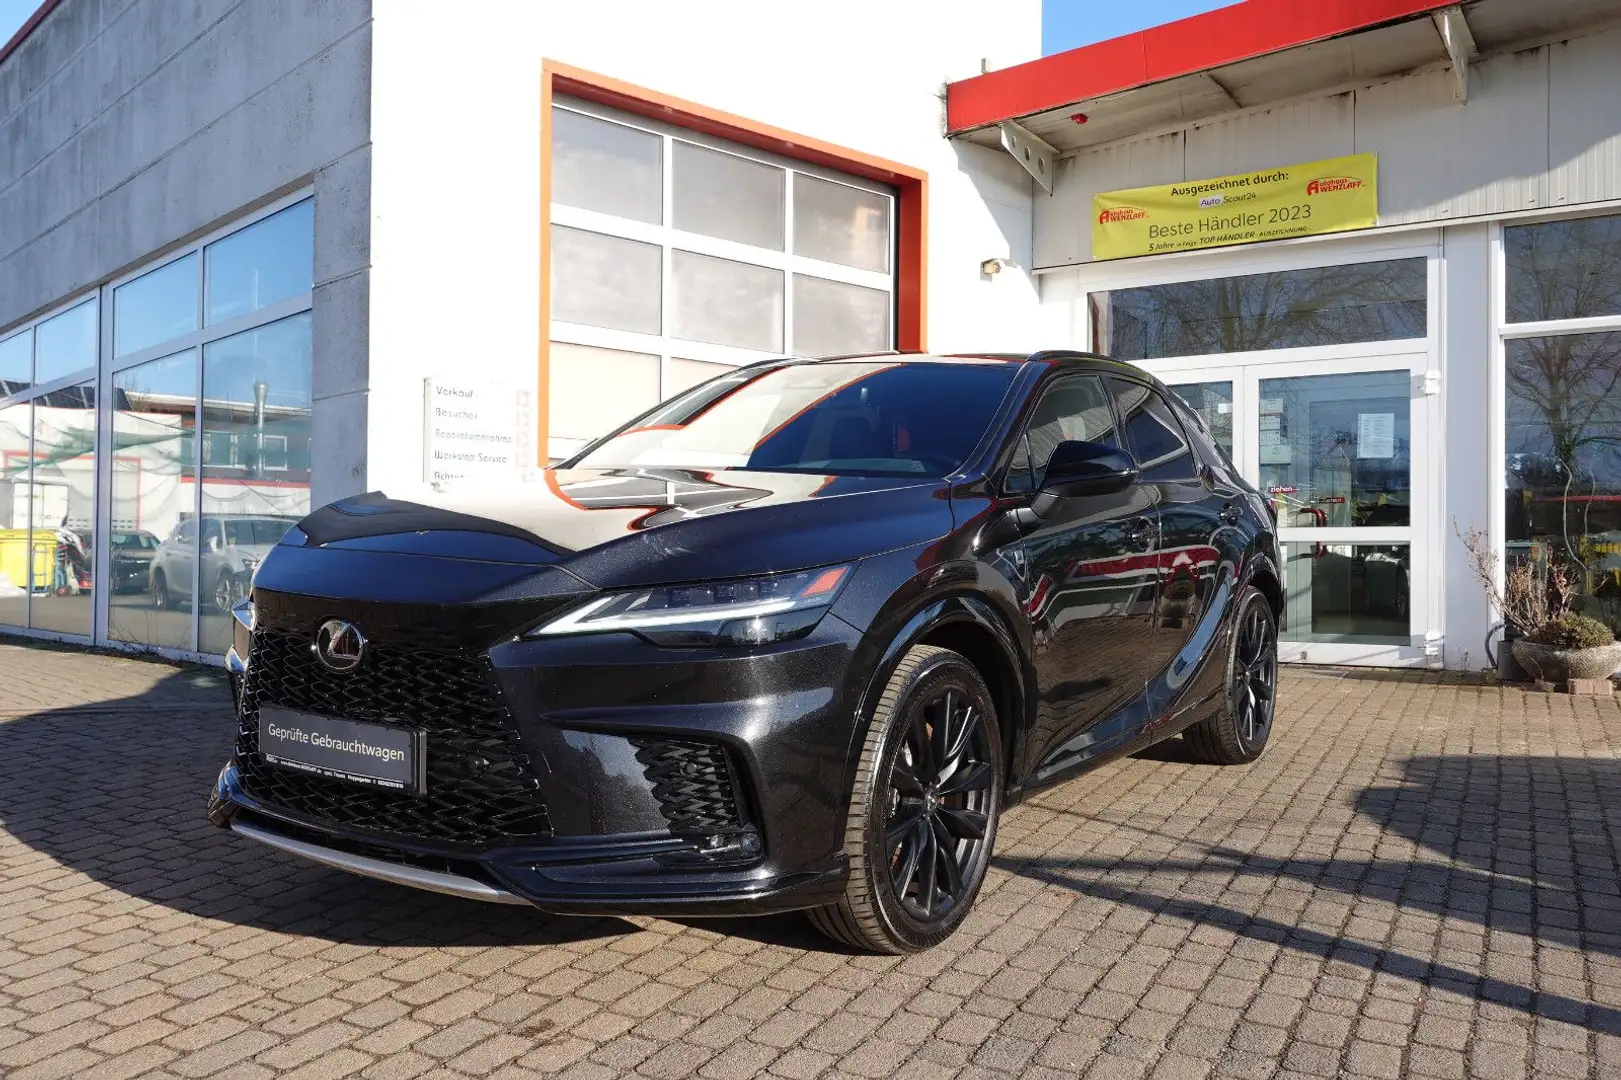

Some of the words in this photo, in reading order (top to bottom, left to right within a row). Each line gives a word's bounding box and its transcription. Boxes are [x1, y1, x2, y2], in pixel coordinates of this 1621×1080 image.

[1171, 178, 1250, 196] Ausgezeichnet
[1253, 171, 1289, 185] durch:
[1149, 222, 1194, 239] Beste
[1199, 212, 1264, 233] Händler
[1268, 204, 1312, 223] 2023
[1149, 243, 1156, 252] 5
[1200, 236, 1215, 245] TOP
[436, 385, 474, 398] Verkauf
[435, 407, 477, 419] Besucher
[478, 452, 507, 464] Service
[1270, 485, 1293, 493] ziehen
[268, 723, 309, 743] Geprüfte
[310, 732, 405, 761] Gebrauchtwagen
